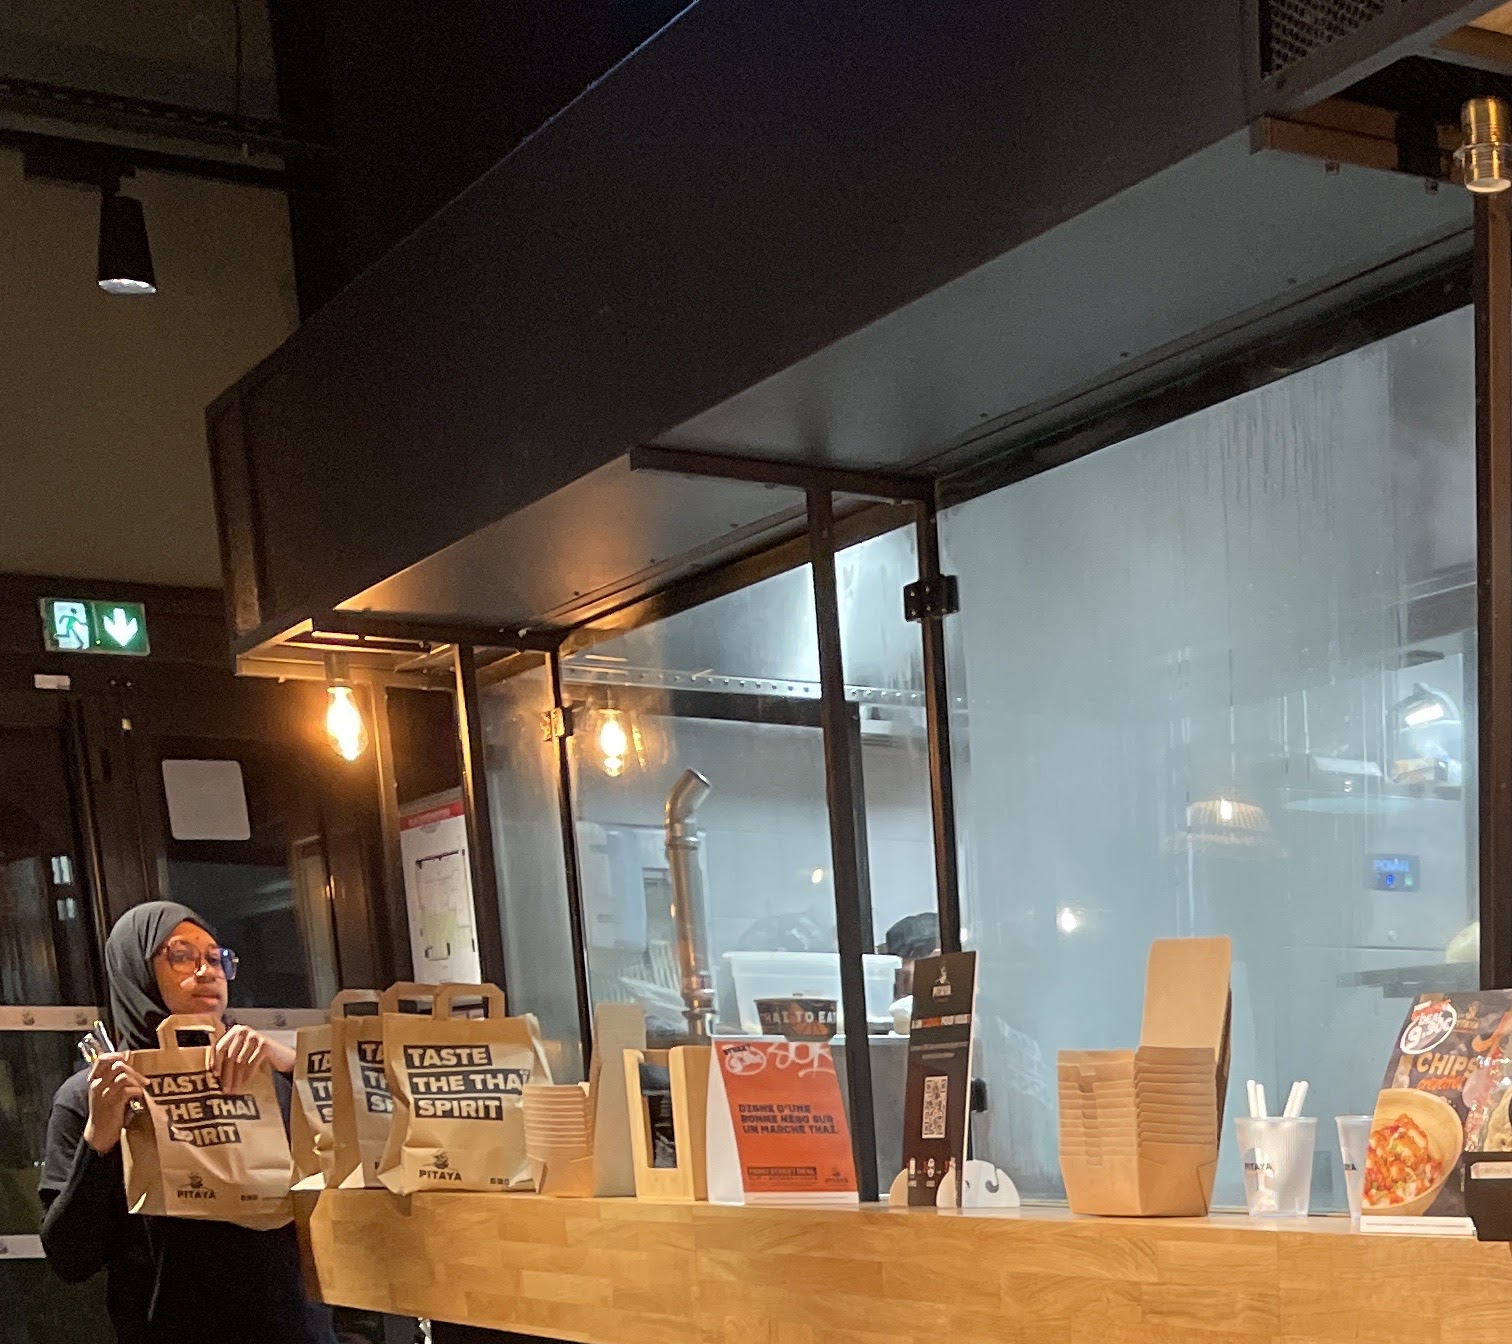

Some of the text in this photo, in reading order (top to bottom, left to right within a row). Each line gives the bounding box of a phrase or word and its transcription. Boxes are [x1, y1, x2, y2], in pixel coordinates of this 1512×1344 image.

[795, 1010, 815, 1023] TO
[407, 1047, 489, 1067] TASTE
[1416, 1051, 1479, 1078] CHIPS
[151, 1071, 219, 1095] TASTE
[412, 1075, 464, 1093] THE
[169, 1103, 203, 1121] HE
[418, 1099, 500, 1118] SPIRIT
[419, 1168, 462, 1182] PITAYA
[177, 1189, 216, 1200] PITAYA
